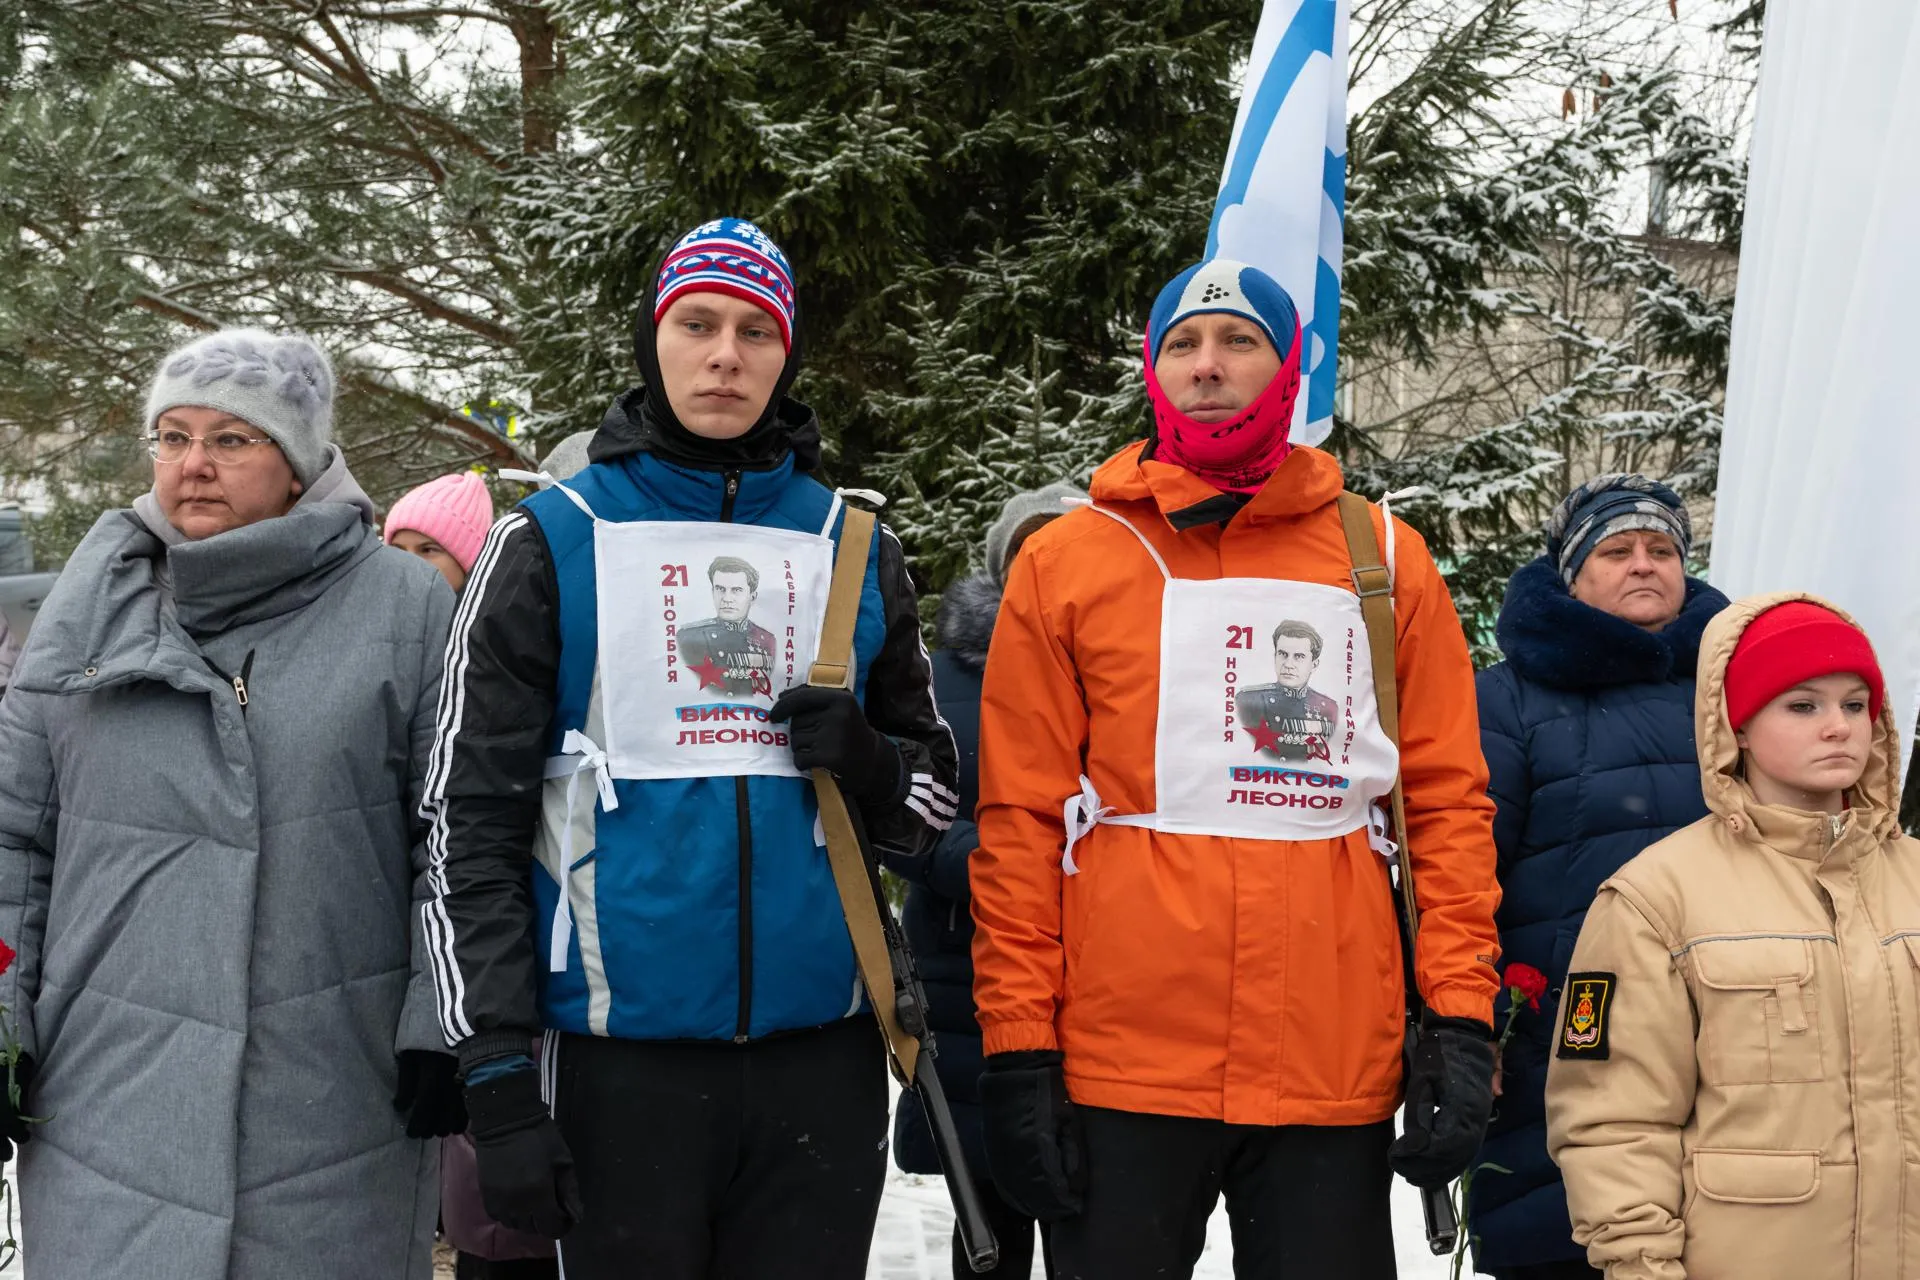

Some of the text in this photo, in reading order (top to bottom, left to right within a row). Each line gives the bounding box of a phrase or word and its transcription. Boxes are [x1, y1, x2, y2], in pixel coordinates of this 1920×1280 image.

[660, 564, 689, 587] 21
[784, 560, 796, 687] ЗАБЕГ ПАМЯТ
[664, 595, 678, 683] НОЯБРЯ
[1225, 625, 1253, 650] 21
[1224, 657, 1237, 742] НОЯБРЯ
[680, 707, 769, 723] ВИКТО
[676, 728, 789, 747] ЛЕОНОВ
[1341, 696, 1356, 765] ПАМЯТИ
[1233, 767, 1345, 789] ВИКТОР
[1227, 789, 1344, 810] ЛЕОНОВ
